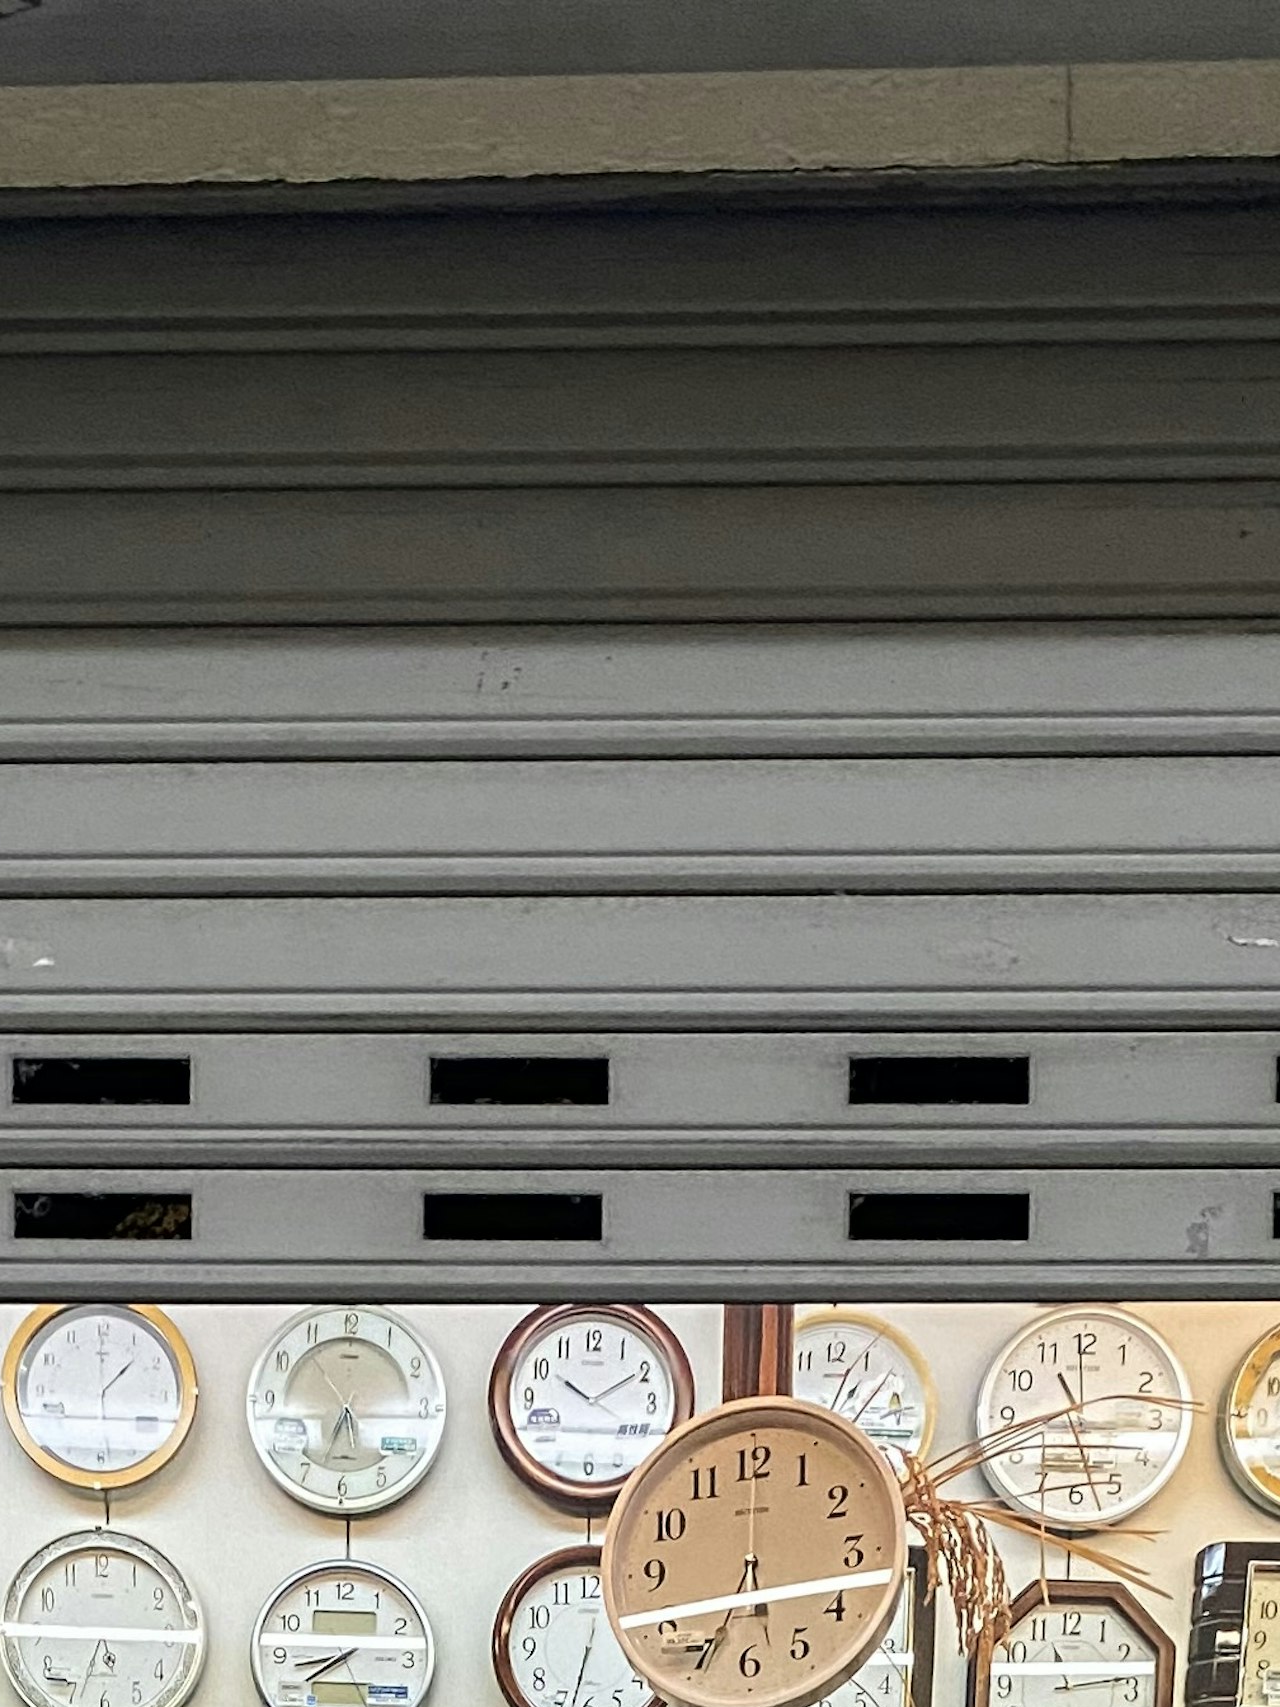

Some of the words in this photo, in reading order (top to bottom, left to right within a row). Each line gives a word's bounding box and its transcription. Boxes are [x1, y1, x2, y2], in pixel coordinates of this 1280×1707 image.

[559, 1337, 569, 1359] 11
[587, 1330, 602, 1351] 12
[621, 1338, 625, 1360] 1
[534, 1358, 548, 1380] 10
[640, 1361, 650, 1383] 2
[524, 1387, 534, 1409] 9
[647, 1392, 656, 1414] 3
[736, 1446, 771, 1482] 12
[798, 1453, 809, 1486] 1
[691, 1466, 719, 1500] 11
[827, 1486, 848, 1518] 2
[654, 1509, 685, 1542] 10
[844, 1534, 863, 1568] 3
[644, 1560, 665, 1592] 9
[823, 1590, 845, 1622] 4
[1261, 1600, 1277, 1619] 10
[1032, 1618, 1045, 1641] 11
[1062, 1611, 1081, 1635] 12
[1100, 1620, 1105, 1642] 1
[790, 1628, 809, 1660] 5
[1254, 1631, 1266, 1650] 9
[739, 1645, 760, 1677] 6
[998, 1676, 1012, 1698] 9
